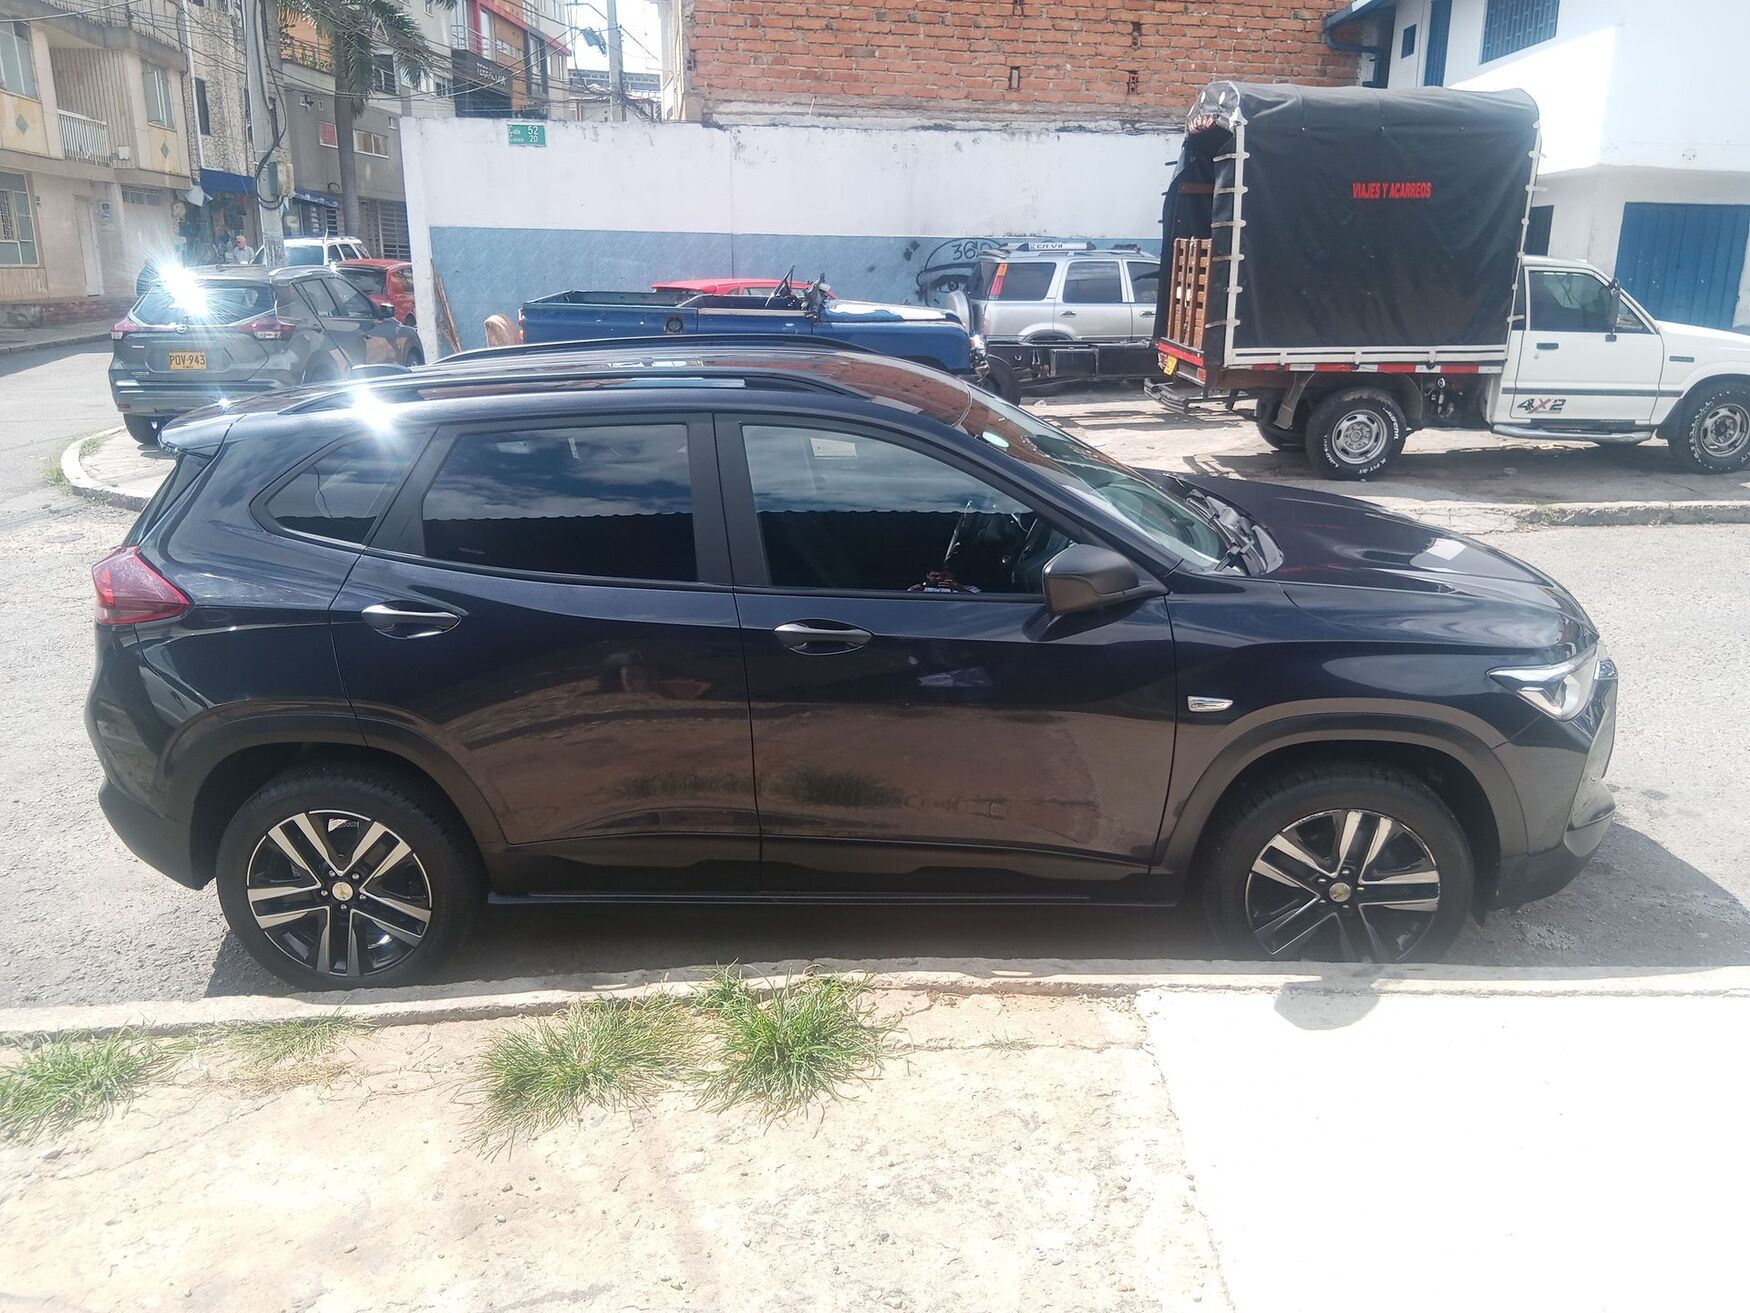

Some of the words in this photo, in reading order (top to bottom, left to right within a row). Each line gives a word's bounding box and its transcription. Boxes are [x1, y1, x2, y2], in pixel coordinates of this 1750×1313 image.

[528, 125, 538, 135] 52
[529, 134, 538, 142] 20
[1353, 182, 1380, 199] VIAJES
[1382, 182, 1388, 199] Y
[1389, 182, 1432, 199] ACARREOS
